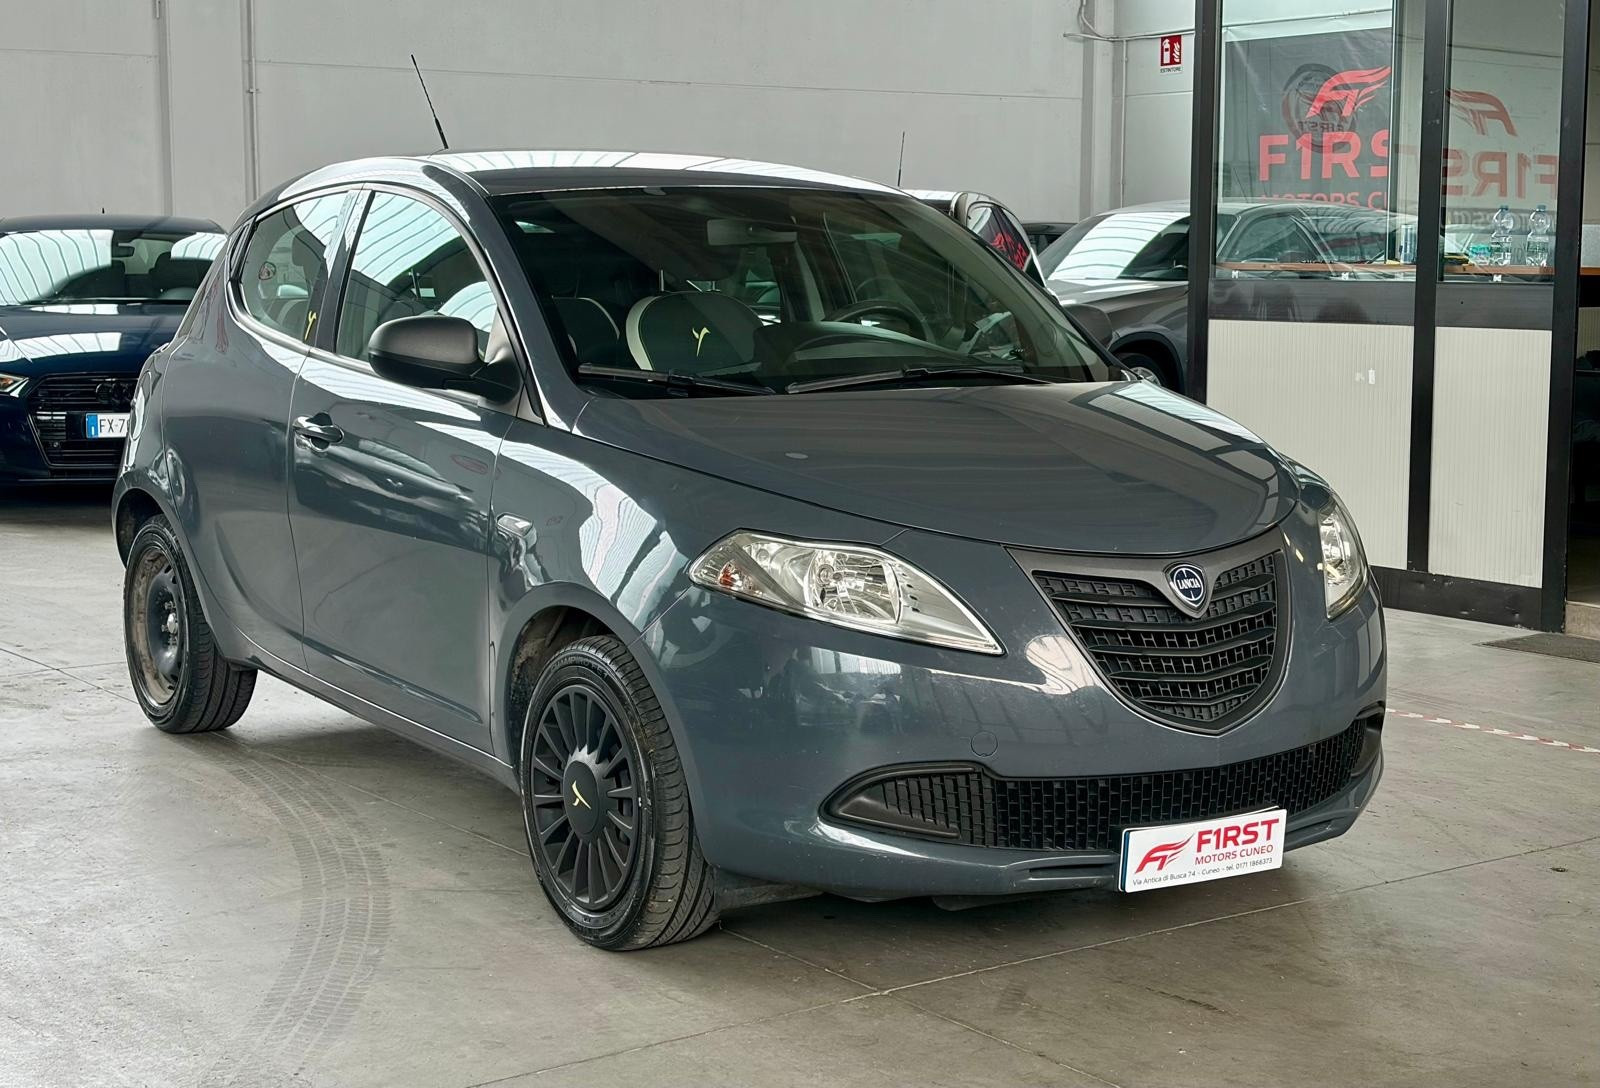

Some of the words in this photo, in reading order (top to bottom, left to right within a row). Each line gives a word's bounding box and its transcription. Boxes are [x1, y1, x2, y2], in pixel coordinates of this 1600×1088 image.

[1177, 578, 1201, 590] LANCIA
[1194, 850, 1237, 866] MOTORS
[1239, 844, 1274, 858] CUNEO
[1143, 876, 1162, 884] Antica
[1163, 873, 1169, 881] di
[1170, 872, 1187, 881] Busca
[1201, 867, 1220, 876] Cuneo
